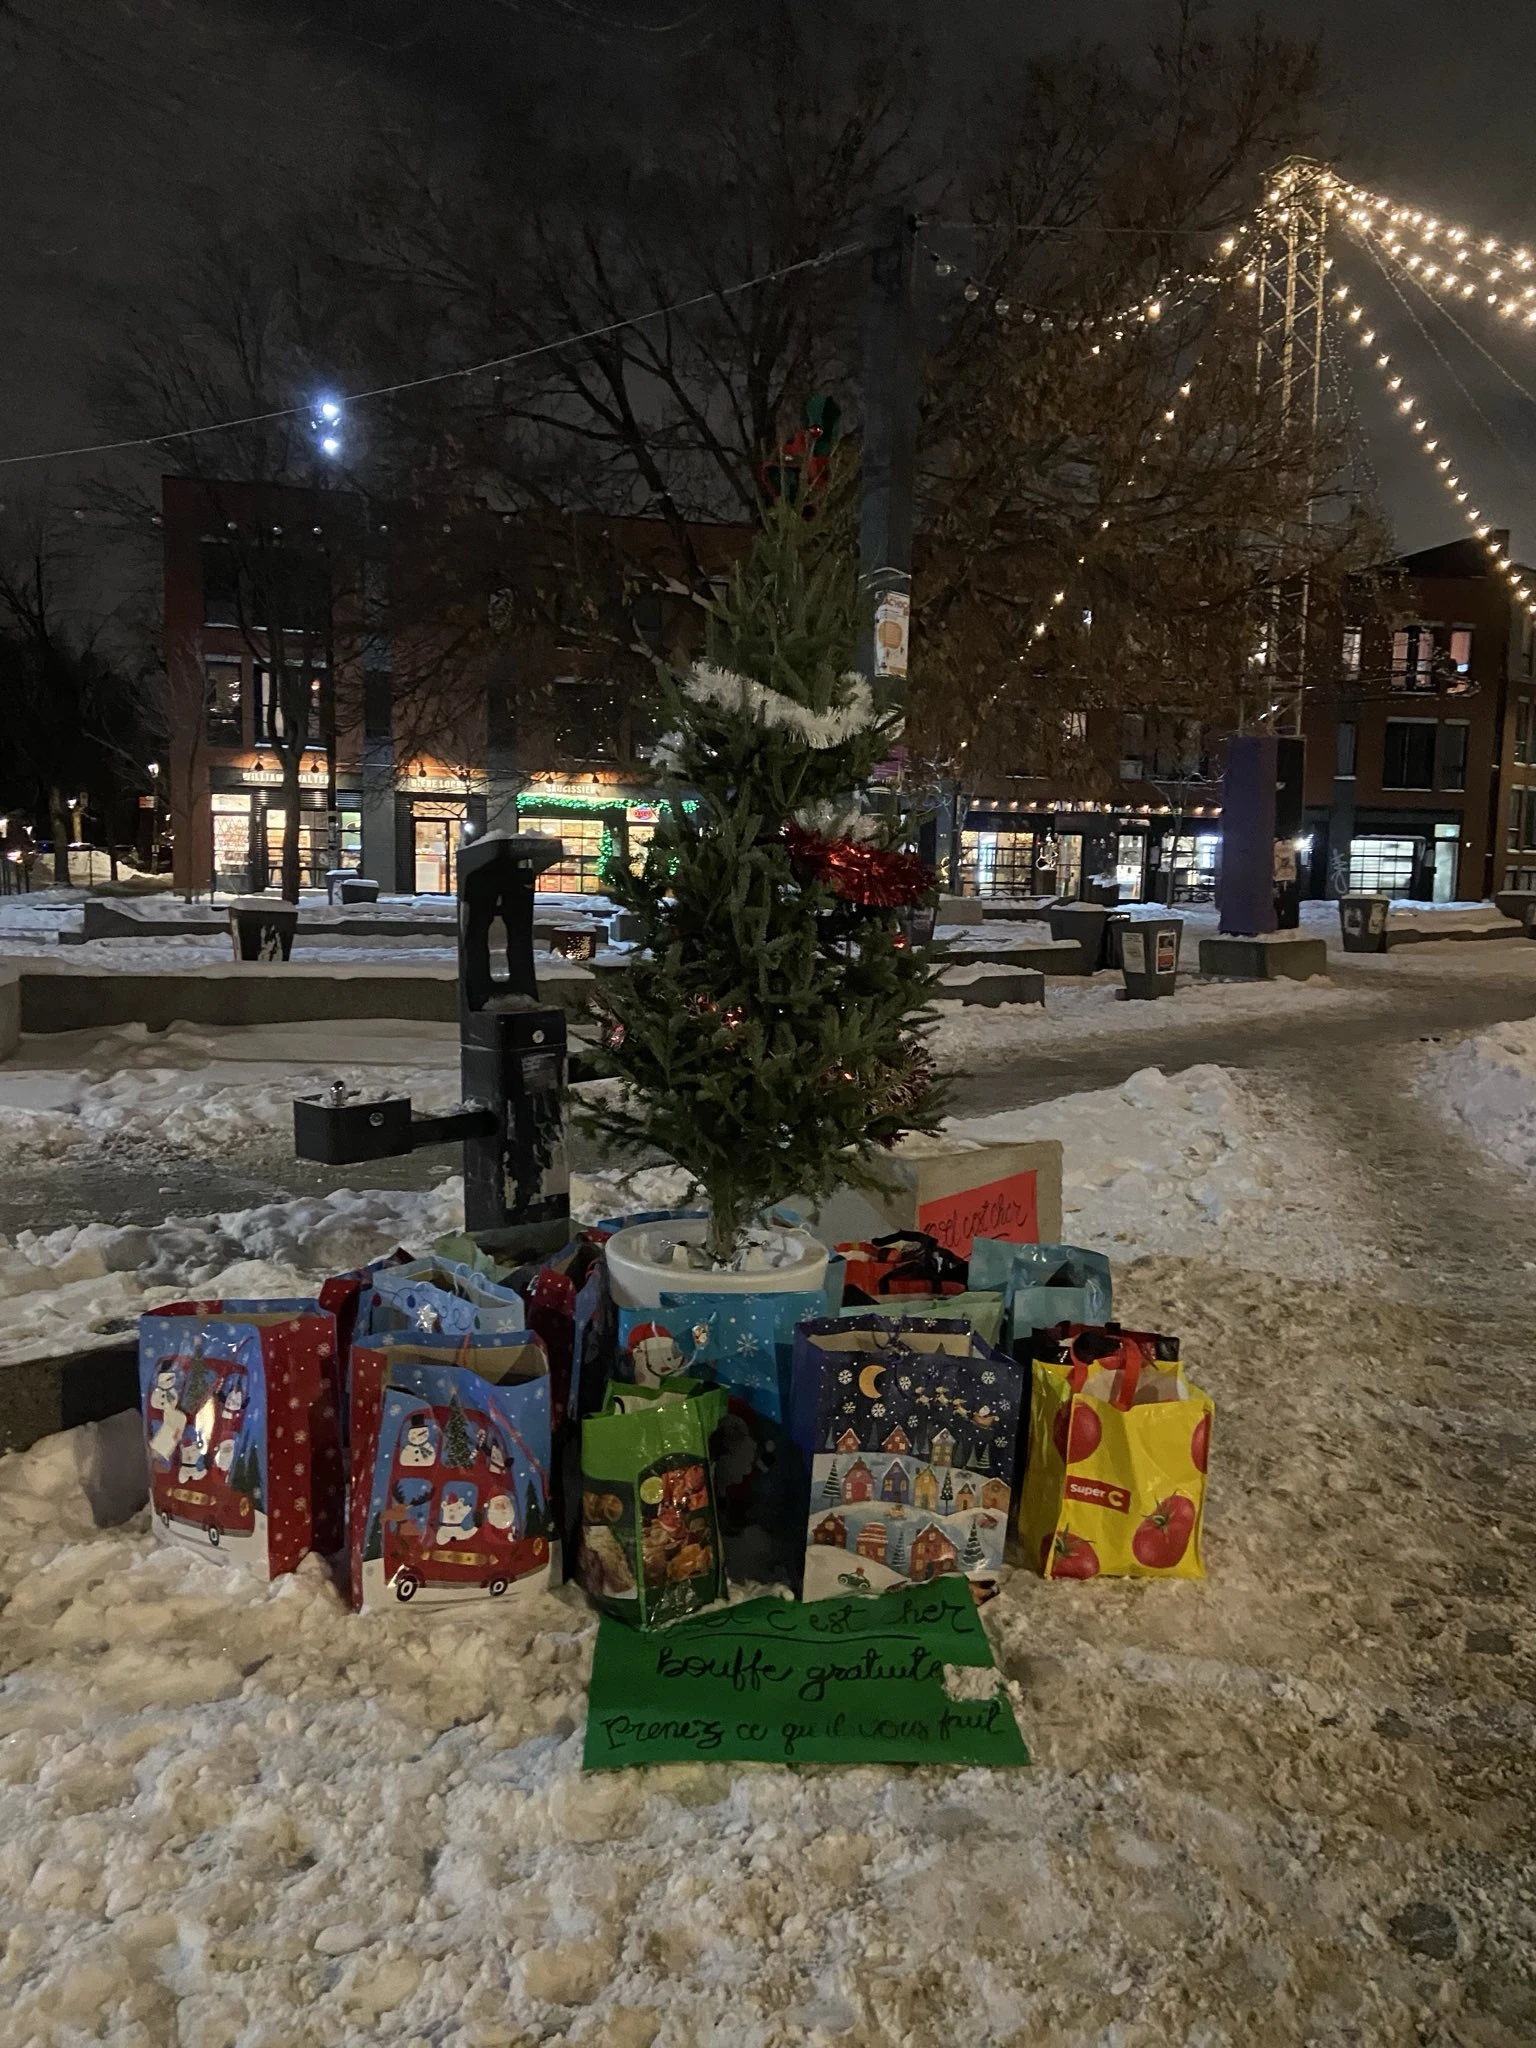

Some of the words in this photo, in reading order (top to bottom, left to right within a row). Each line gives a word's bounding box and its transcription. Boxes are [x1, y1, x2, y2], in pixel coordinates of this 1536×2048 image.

[242, 772, 284, 782] WILLIAM
[1070, 1483, 1106, 1498] super
[1108, 1490, 1124, 1507] C
[656, 1645, 794, 1692] Bouffe
[798, 1646, 945, 1703] gratuite
[600, 1714, 725, 1750] Prenez
[736, 1722, 768, 1742] ce
[857, 1719, 929, 1743] vous
